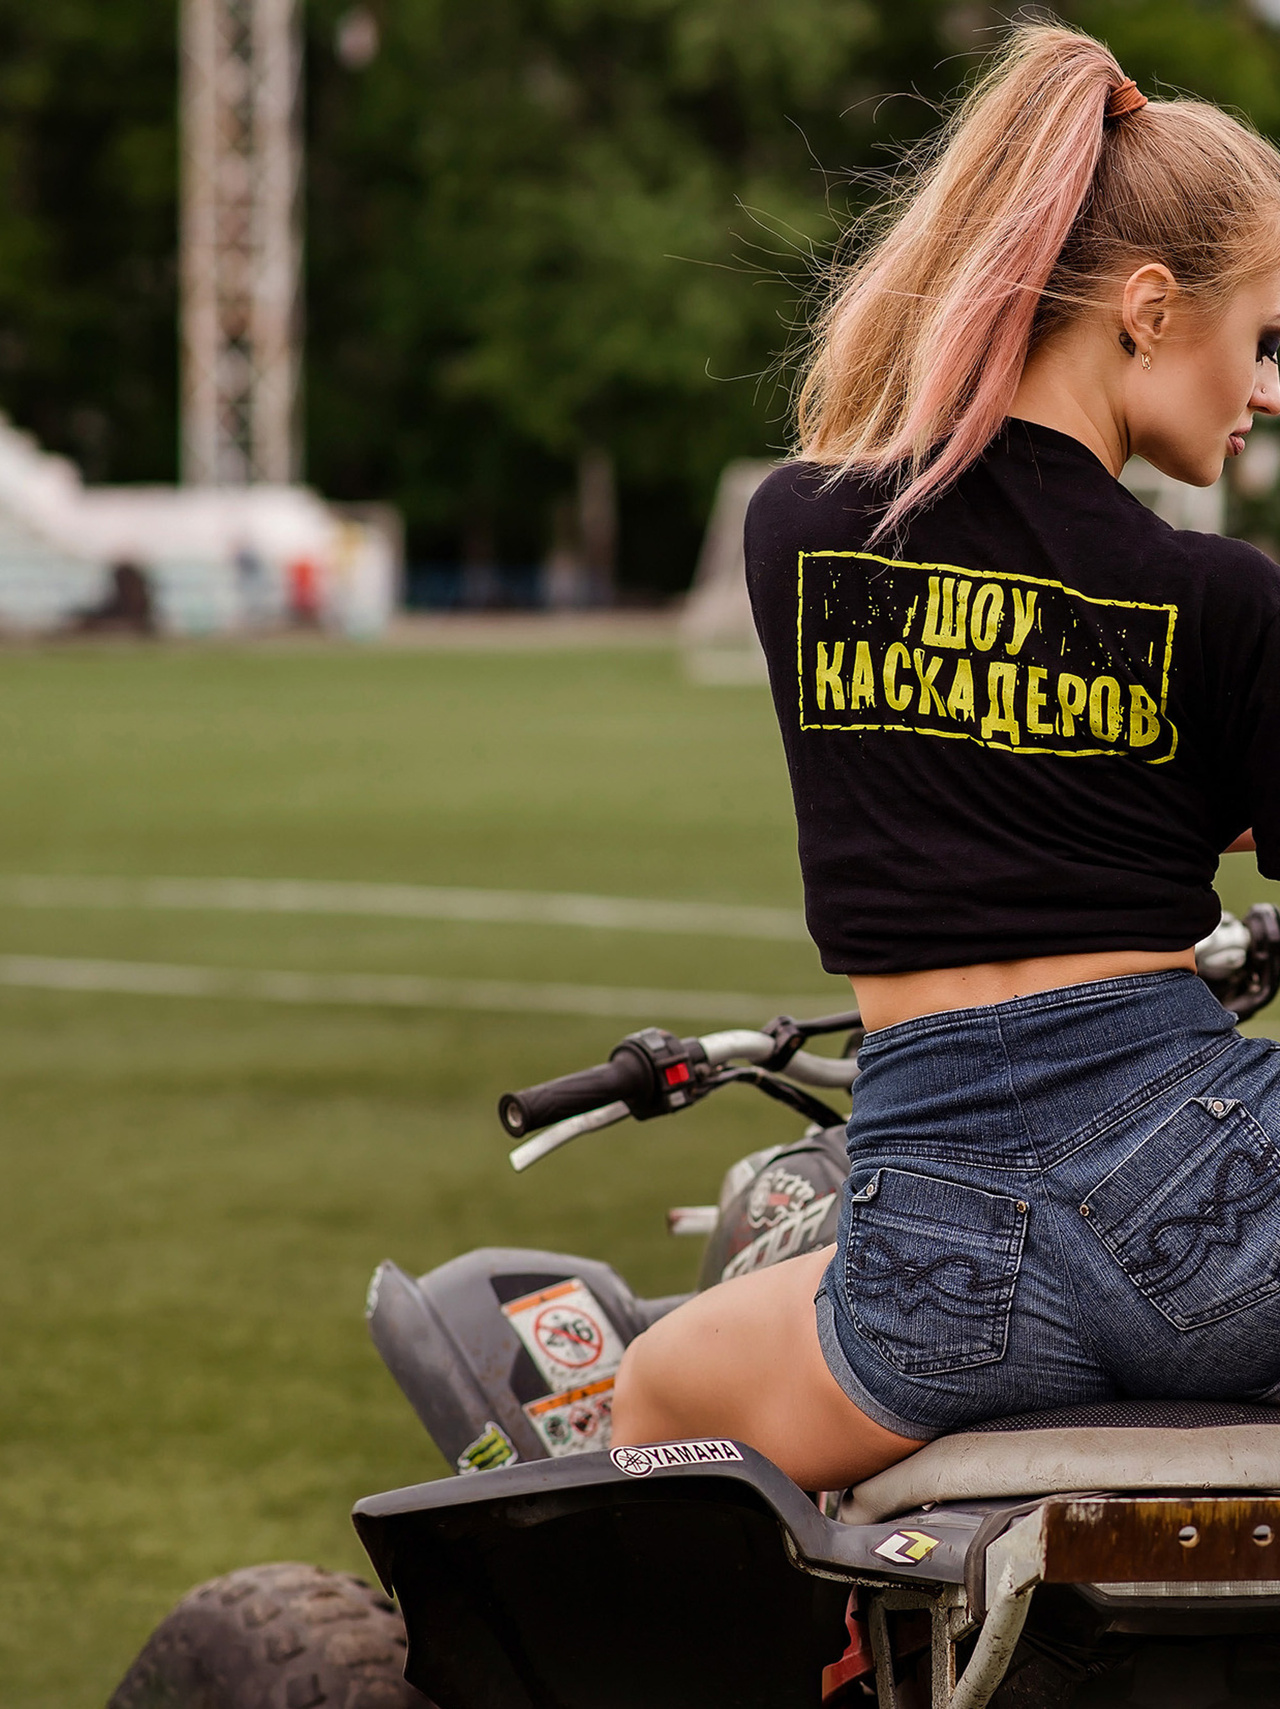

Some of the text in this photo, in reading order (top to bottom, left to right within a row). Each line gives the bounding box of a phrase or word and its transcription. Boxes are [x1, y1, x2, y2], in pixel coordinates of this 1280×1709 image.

[920, 576, 1038, 656] ШОУ
[815, 640, 1161, 748] КАСКАДЕРОВ
[647, 1442, 739, 1466] YAMAHA
